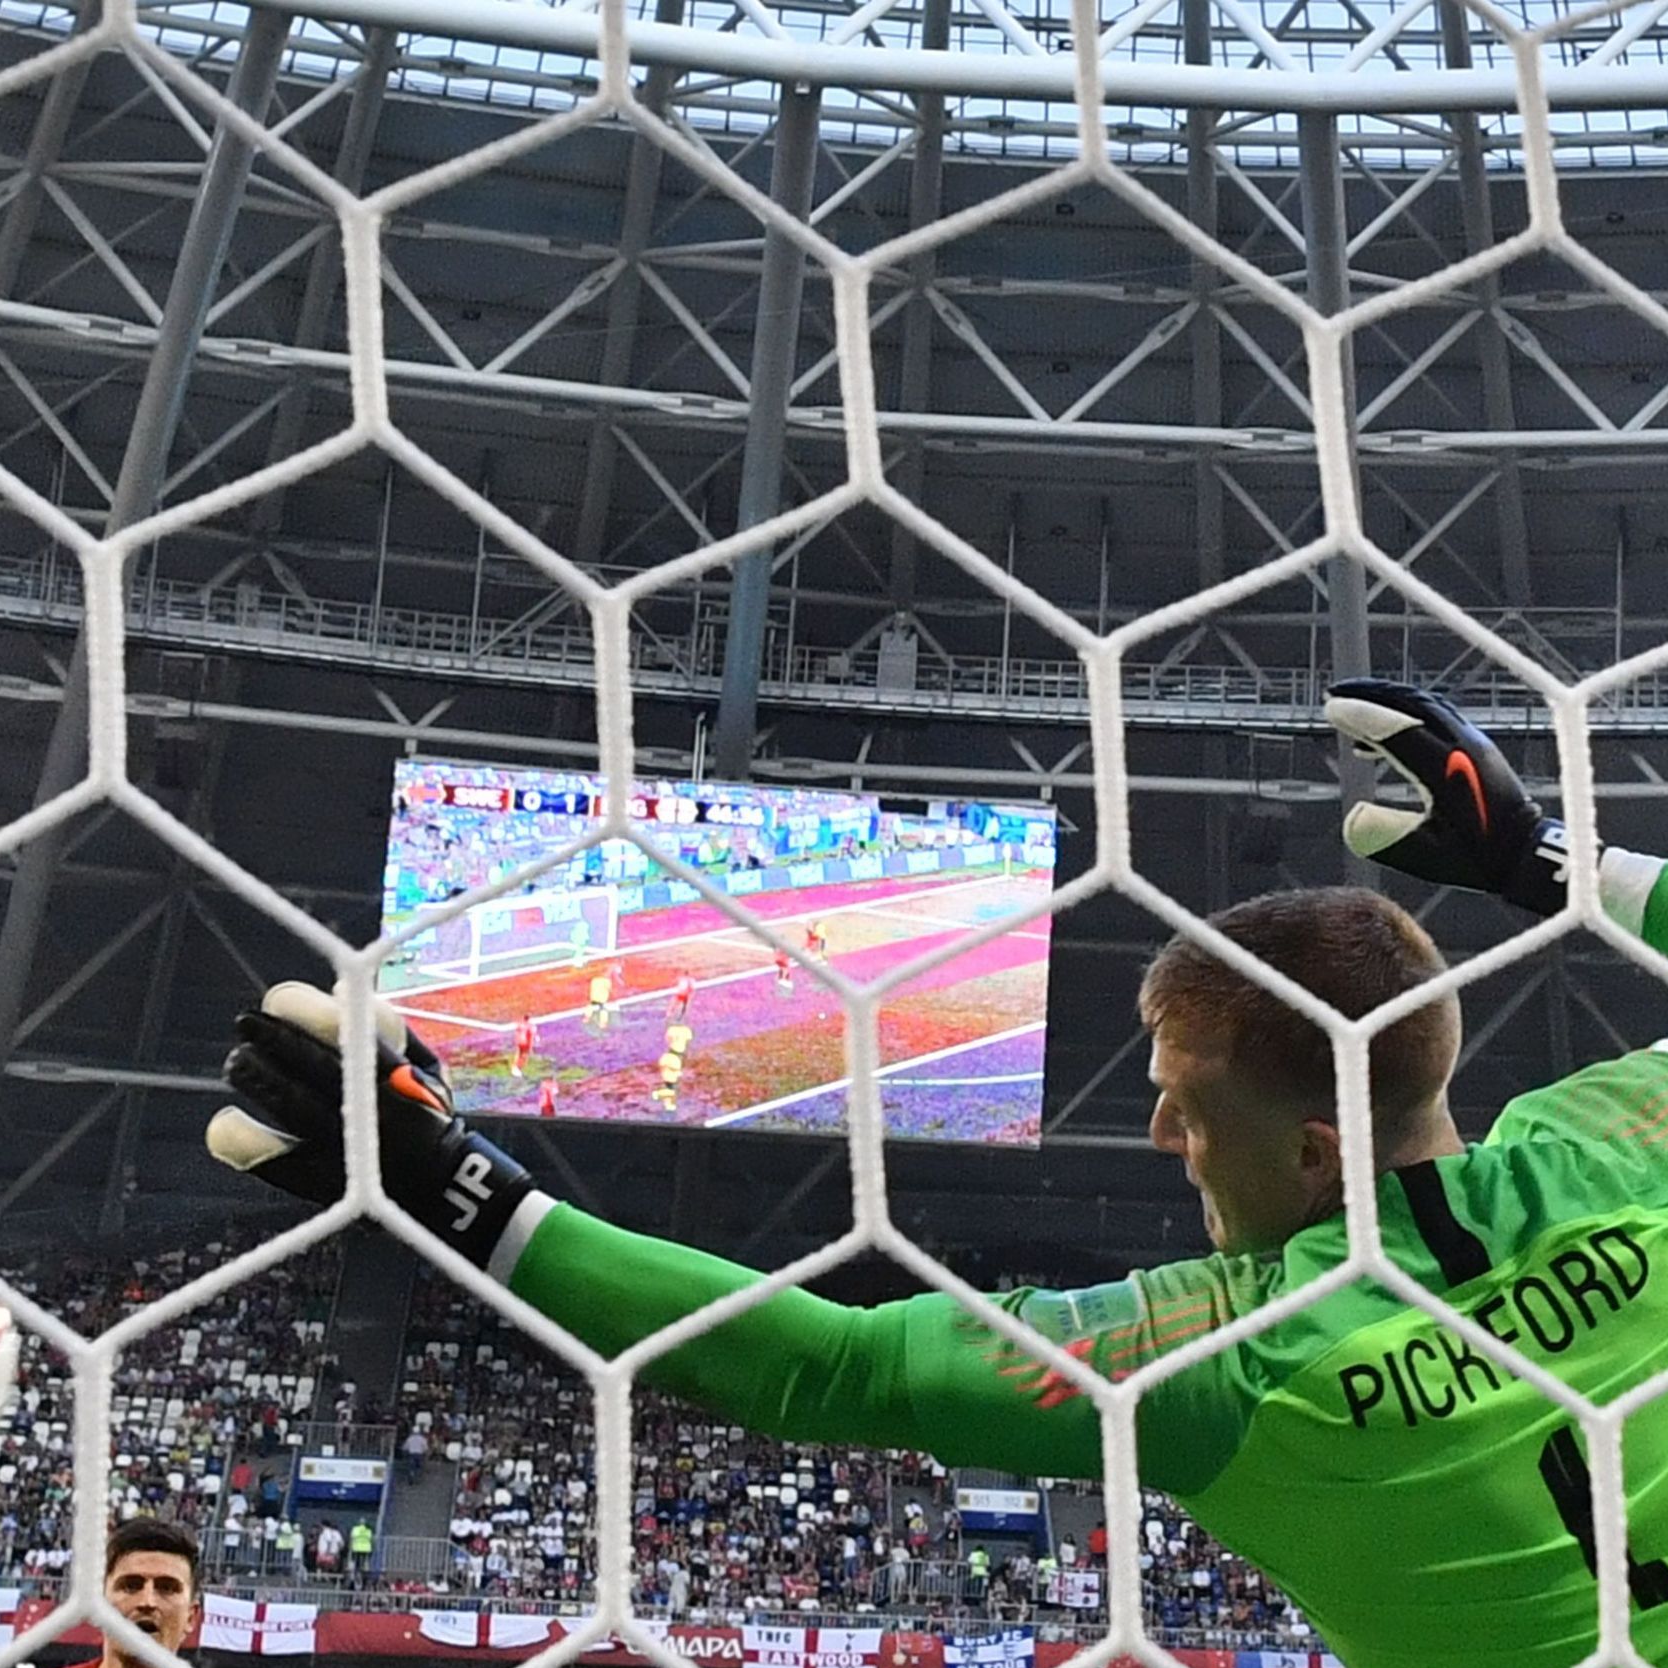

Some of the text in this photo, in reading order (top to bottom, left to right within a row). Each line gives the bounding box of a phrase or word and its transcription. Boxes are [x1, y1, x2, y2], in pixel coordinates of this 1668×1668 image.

[444, 1152, 494, 1232] JP
[1338, 1227, 1650, 1428] PICKFORD
[759, 1651, 864, 1668] EASTWOOD
[953, 1633, 997, 1647] BURY
